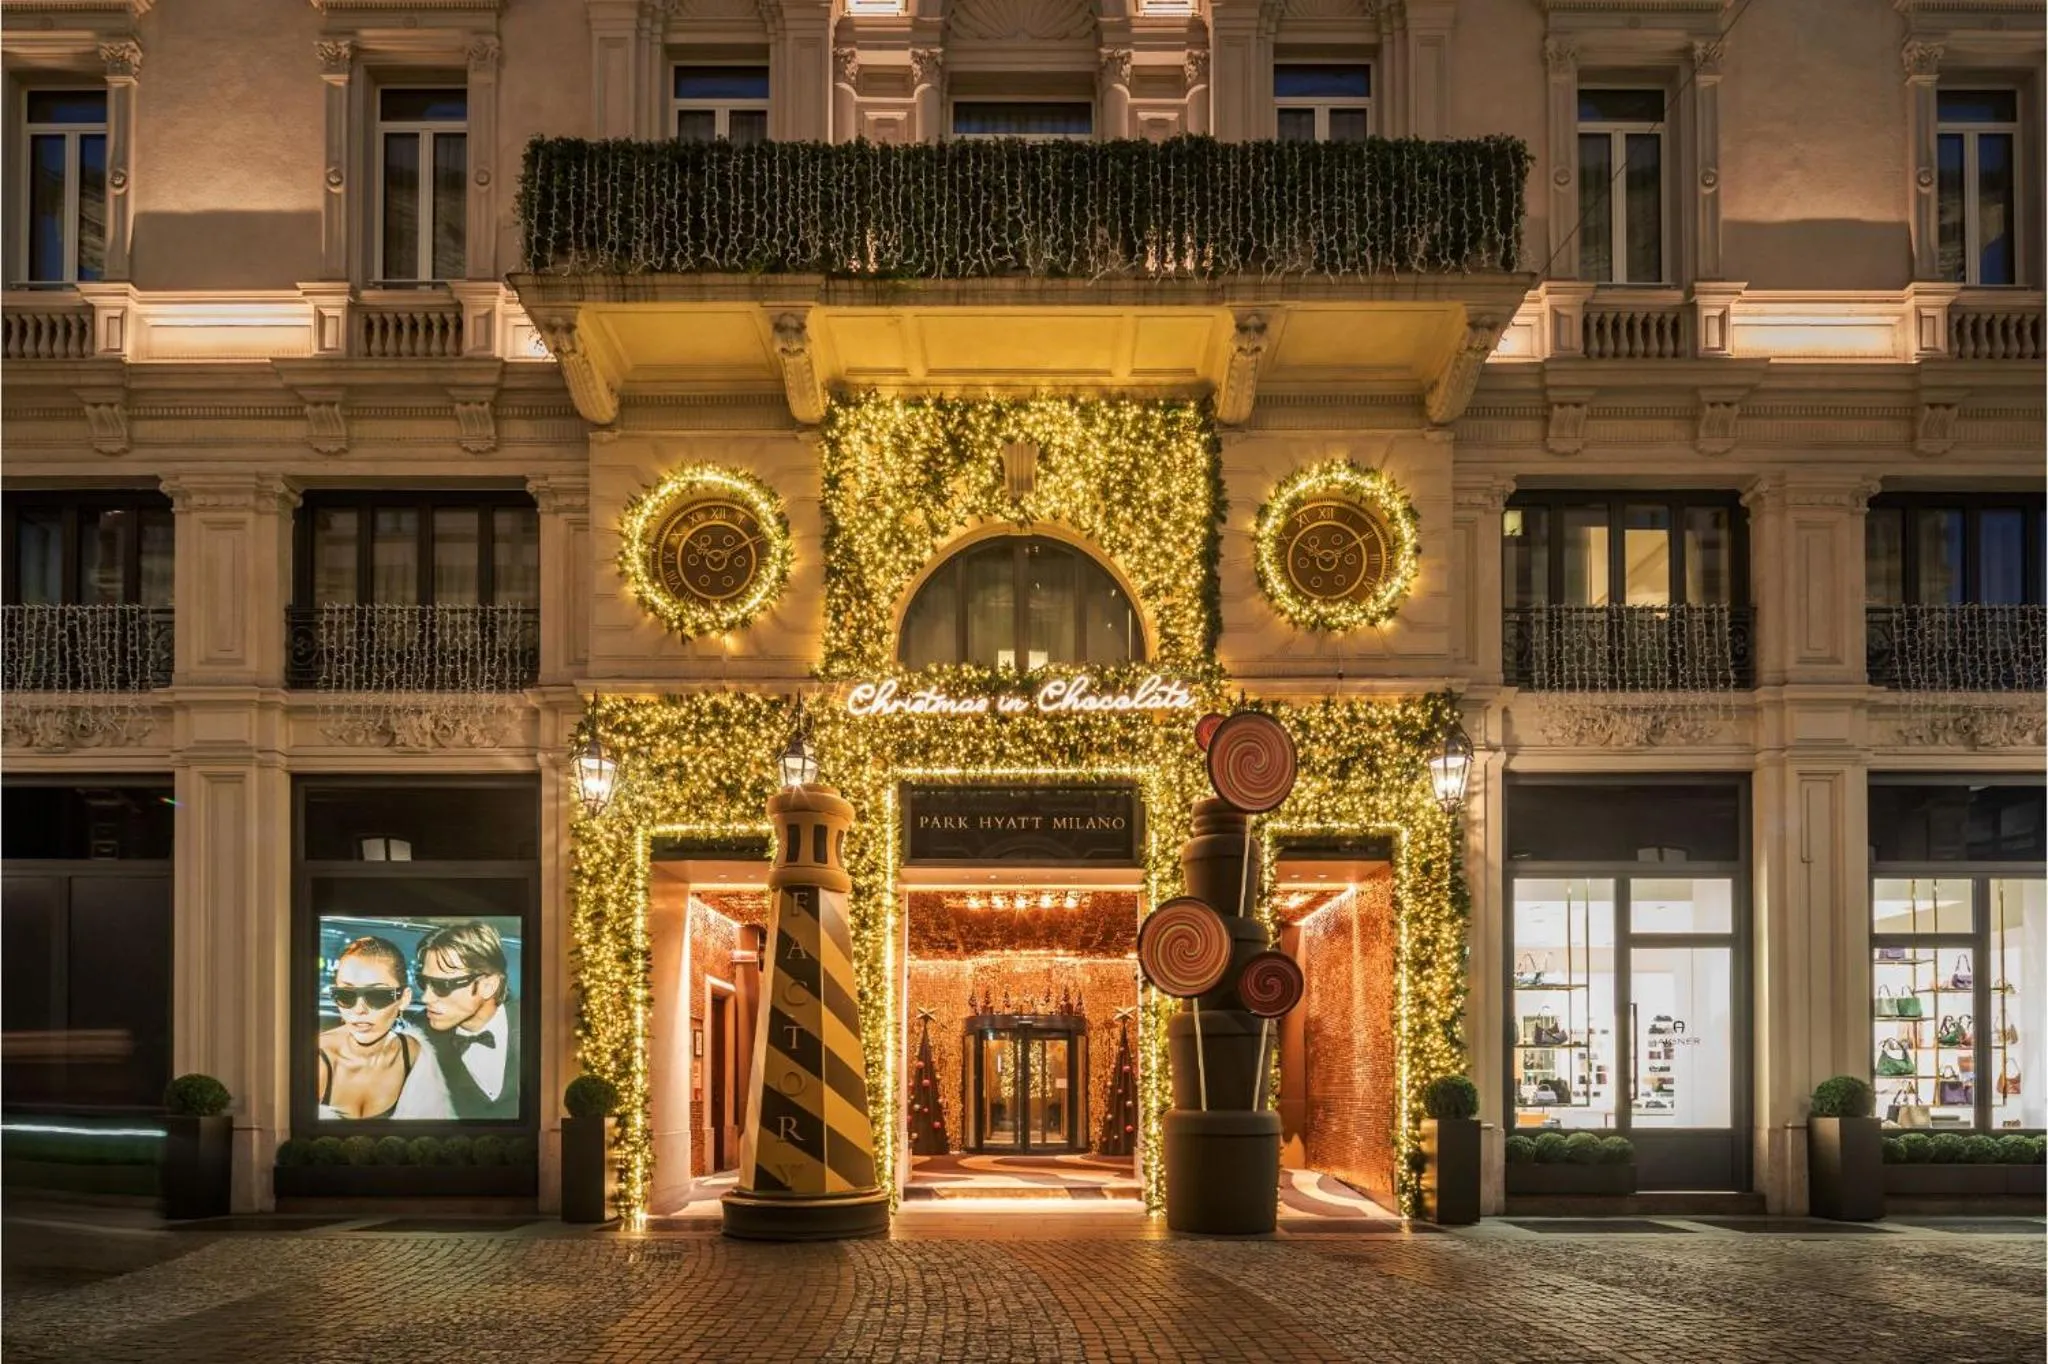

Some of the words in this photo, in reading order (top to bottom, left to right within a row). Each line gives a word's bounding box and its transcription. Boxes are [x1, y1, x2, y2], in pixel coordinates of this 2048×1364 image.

[710, 507, 726, 520] XII
[1318, 507, 1334, 520] XII
[848, 679, 988, 715] Christmas
[997, 694, 1030, 713] in
[1037, 675, 1196, 712] Chocolate
[919, 815, 969, 830] PARK
[979, 815, 1043, 830] HYATT
[1053, 815, 1126, 830] MILANO
